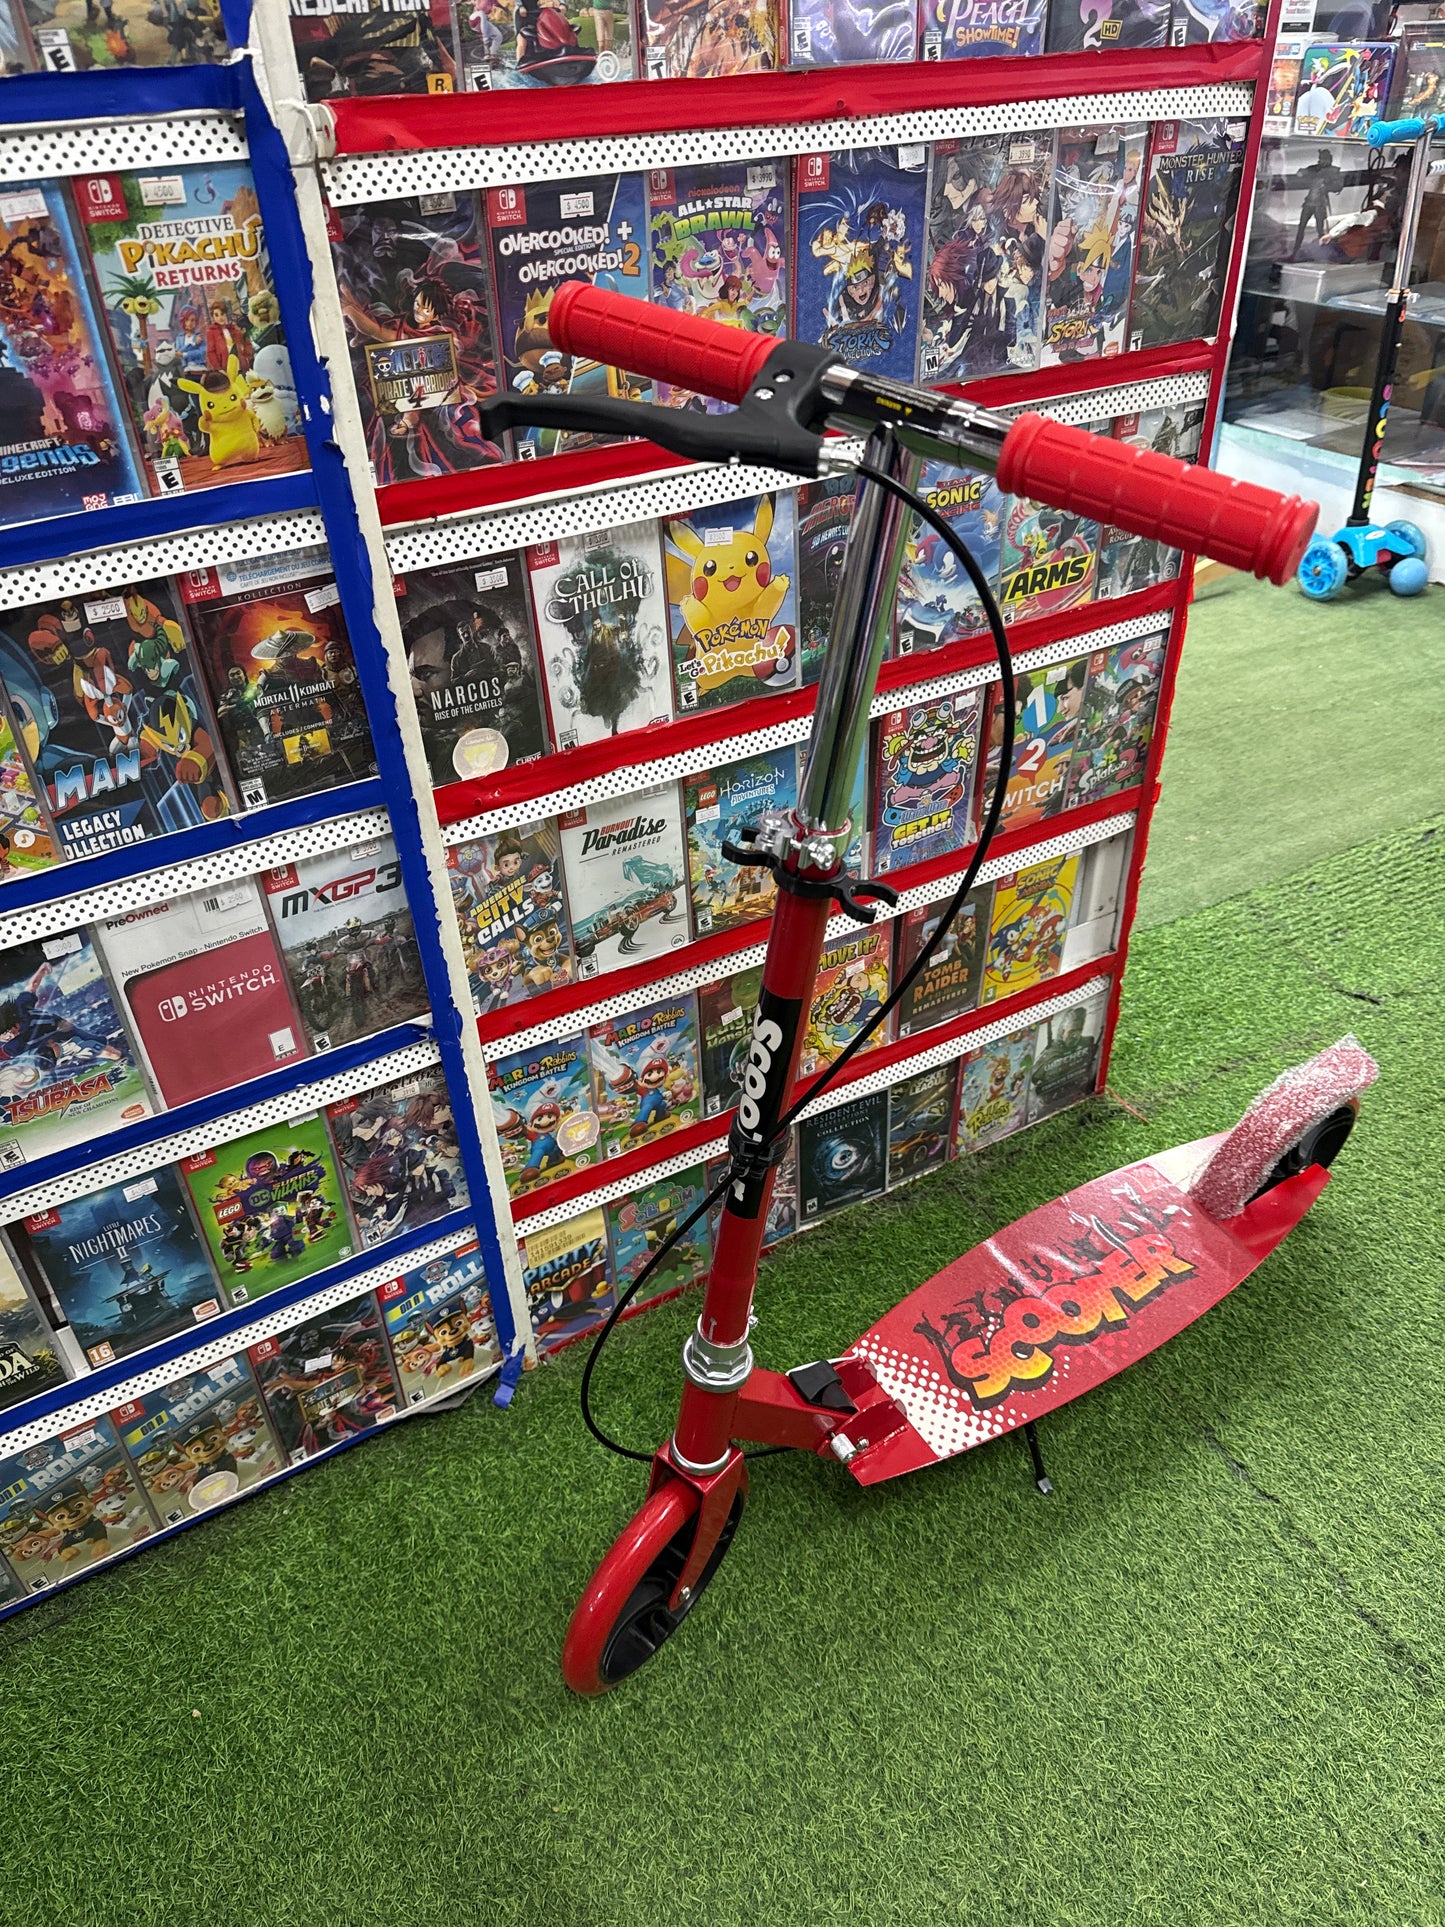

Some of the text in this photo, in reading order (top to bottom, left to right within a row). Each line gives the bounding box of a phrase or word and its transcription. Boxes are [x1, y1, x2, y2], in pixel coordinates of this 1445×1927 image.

[956, 24, 1021, 48] SHOWTIME!
[1103, 23, 1119, 36] HD
[1172, 26, 1186, 46] E
[51, 49, 70, 71] E
[475, 74, 491, 90] E
[1159, 150, 1242, 170] MONSTER HUNTER
[758, 172, 773, 183] 3990
[1185, 168, 1215, 184] RISE
[154, 185, 174, 197] 4500
[650, 194, 672, 202] SWITCH
[89, 207, 122, 217] SWITCH
[574, 199, 590, 211] 4500
[678, 196, 753, 217] ALL STAR
[140, 216, 234, 239] DETECTIVE
[497, 212, 522, 222] SWITCH
[673, 211, 756, 241] BRAWL
[118, 217, 263, 274] PIKACHU
[499, 222, 611, 256] OVERCOOKED!
[554, 242, 596, 256] SPECIAL EDITION
[518, 242, 641, 283] OVERCOOKED! 2
[155, 261, 241, 287] RETURNS
[926, 355, 938, 371] M
[35, 466, 77, 480] EDITION
[161, 471, 179, 490] E
[926, 481, 982, 510] SONIC
[940, 501, 981, 518] ACING
[535, 556, 556, 566] SWITCH
[555, 566, 616, 599] CALL
[1008, 556, 1090, 600] ARMS
[189, 589, 217, 599] SWITCH
[237, 582, 302, 602] KOLLECTION
[544, 572, 655, 624] CTHULHU
[102, 604, 121, 616] 2500
[694, 617, 770, 653] Pokémon
[902, 638, 912, 653] E
[703, 626, 791, 674] Pikachu!
[679, 660, 703, 674] Let's
[254, 680, 336, 709] MORTAL 11 KOMBAT
[430, 676, 501, 711] NARCOS
[683, 692, 695, 705] E
[269, 696, 327, 717] AFTERMATH
[434, 697, 503, 721] RISE OF THE CARTELS
[1026, 684, 1048, 729] 1
[1018, 738, 1047, 772] 2
[54, 749, 142, 810] MAN
[1078, 749, 1142, 795] Splatoon 2
[246, 789, 263, 806] M
[699, 788, 717, 801] LEGO
[731, 784, 776, 806] ADVENTURES
[62, 810, 123, 841] LEGACY
[564, 818, 583, 828] SWITCH
[601, 817, 636, 837] BURNOUT
[893, 809, 953, 840] GET IT
[64, 824, 146, 860] OLLECTION
[581, 815, 668, 856] Paradise
[611, 835, 661, 857] REMASTERED
[271, 878, 295, 891] SWITCH
[1017, 864, 1060, 890] SONIC
[281, 860, 402, 919] MXGP3
[469, 874, 527, 919] ADVENTURE
[105, 902, 170, 931] PreOwned
[476, 885, 526, 930] CITY
[476, 897, 536, 946] CALLS
[699, 917, 711, 929] E
[121, 925, 263, 979] New Pokemon Snap Nintendo Switch
[673, 937, 683, 947] EA
[857, 934, 880, 956] IT!
[584, 962, 596, 974] E
[924, 959, 962, 980] TOMB
[188, 964, 273, 998] NINTENDO
[913, 968, 969, 1004] RAIDER
[191, 973, 276, 1012] SWITCH
[912, 988, 968, 1015] REMASTERED
[986, 987, 994, 998] 3
[604, 1006, 686, 1047] MARIO Rabbids
[617, 1019, 677, 1049] KINGDOM BATTLE
[316, 1036, 329, 1050] E
[489, 1051, 577, 1092] MARIO Rabbids
[503, 1063, 568, 1094] KINGDOM BATTLE
[27, 1078, 74, 1101] CAPTAIN
[909, 1076, 947, 1096] LEAGUE
[4, 1073, 113, 1126] TSUBASA
[67, 1109, 82, 1119] NEW
[82, 1097, 119, 1114] CHAMPIONS
[69, 1101, 92, 1113] RISE OF
[806, 1096, 882, 1128] RESIDENT EVIL
[816, 1116, 870, 1137] COLLECTION
[3, 1151, 20, 1163] E
[190, 1158, 213, 1170] SWITCH
[251, 1190, 271, 1206] DC
[271, 1172, 319, 1202] VILLAINS
[217, 1201, 242, 1220] LEGO
[31, 1218, 57, 1232] SWITCH
[103, 1221, 121, 1233] LITTLE
[69, 1213, 162, 1265] NIGHTMARES
[367, 1231, 380, 1243] M
[116, 1246, 130, 1260] II
[529, 1257, 593, 1295] ARCADE
[400, 1301, 412, 1315] ON
[950, 1232, 1197, 1402] SCOOTER
[88, 1345, 110, 1363] 16
[14, 1365, 41, 1381] WILD
[168, 1367, 245, 1423] ROLL!
[27, 1431, 111, 1491] ROLL!
[167, 1511, 182, 1523] E
